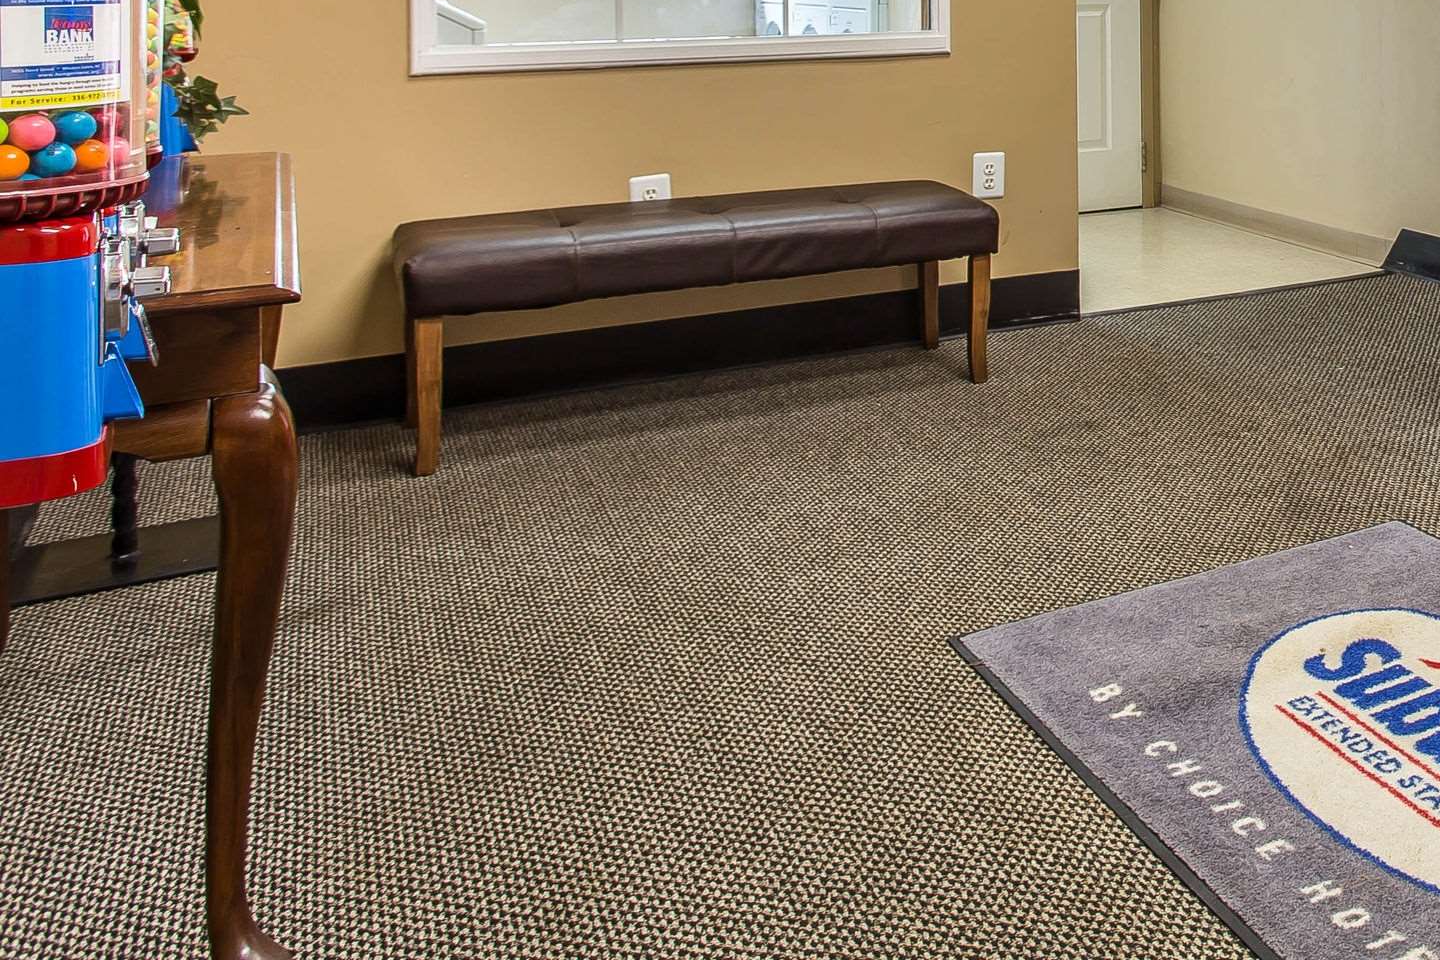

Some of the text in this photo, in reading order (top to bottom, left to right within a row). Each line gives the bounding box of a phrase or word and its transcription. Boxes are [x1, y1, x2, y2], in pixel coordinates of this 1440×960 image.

[46, 28, 93, 44] BANK
[10, 93, 66, 105] For Service:
[1287, 694, 1404, 775] EXTENDED
[1089, 682, 1143, 720] BY
[1145, 740, 1296, 862] CHOICE
